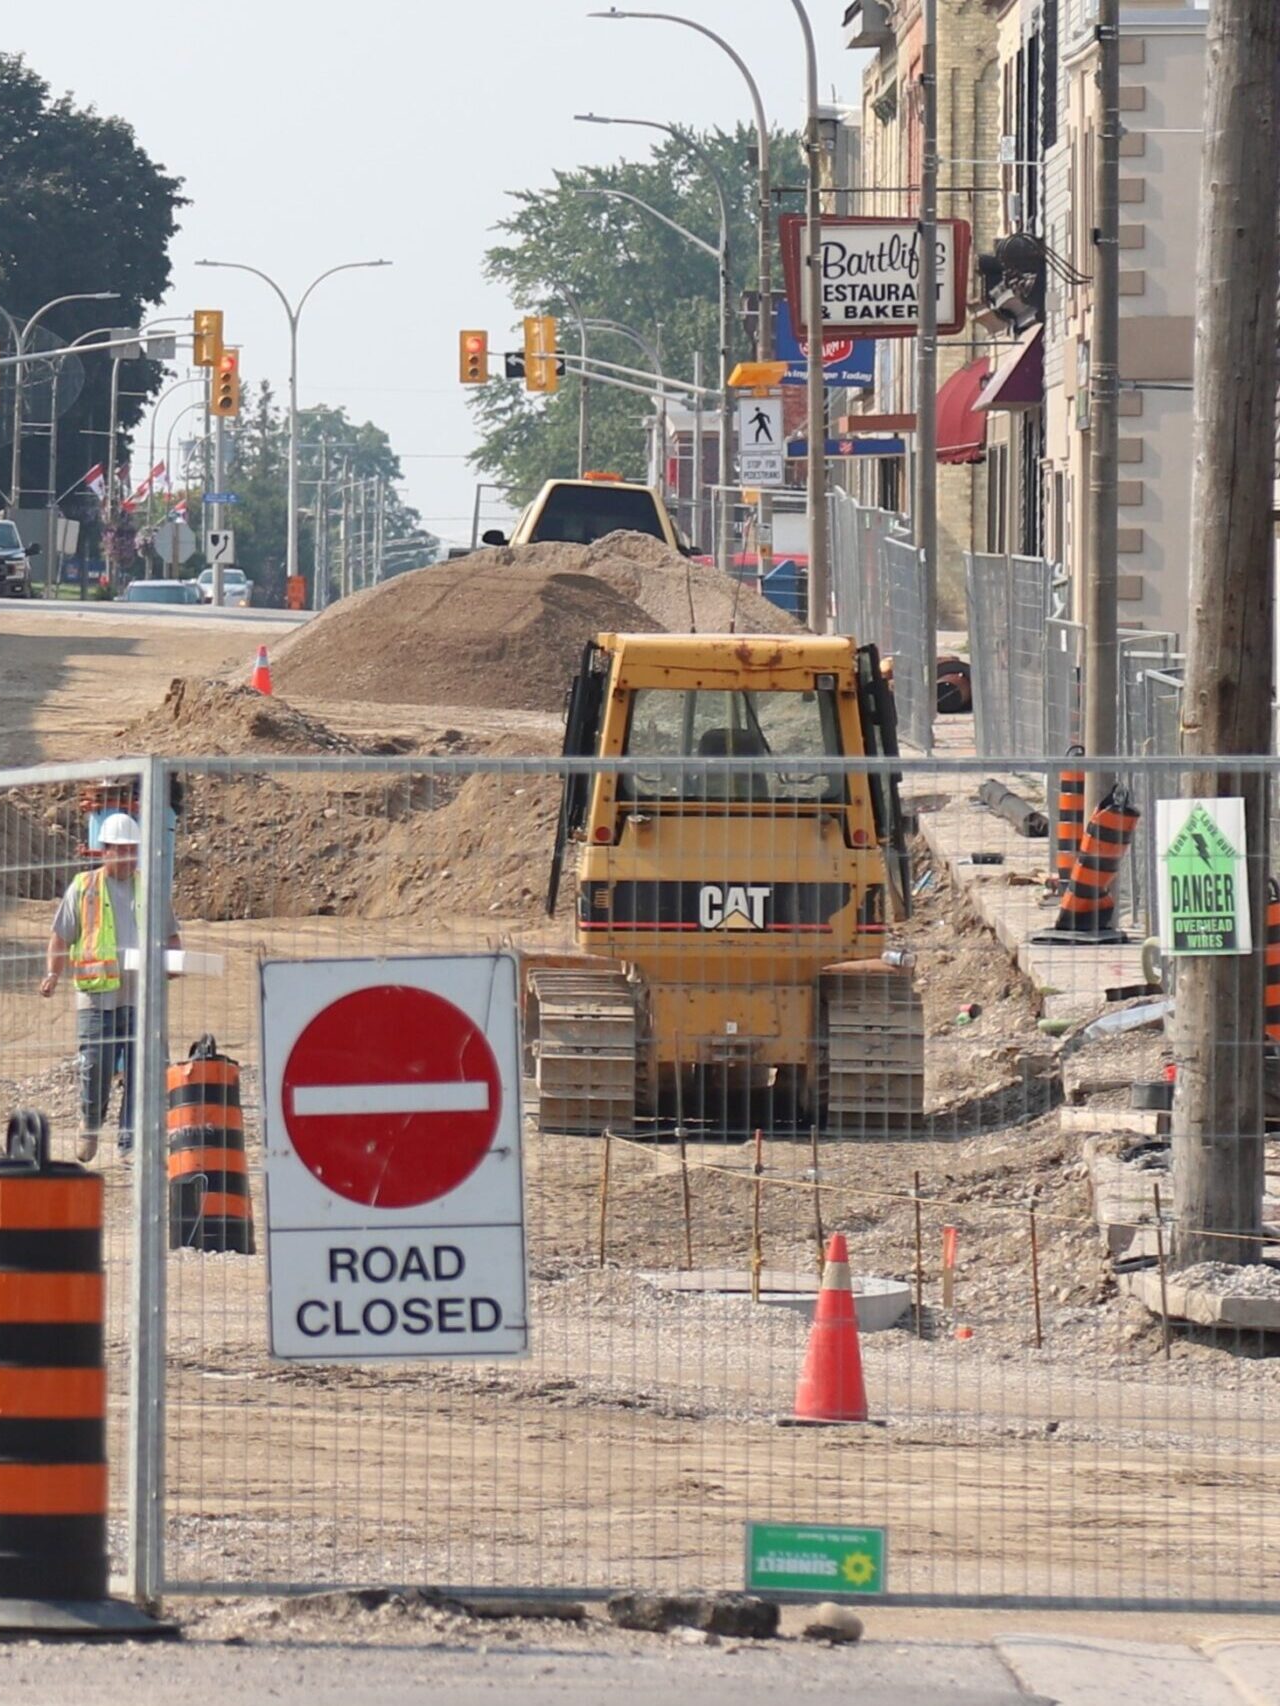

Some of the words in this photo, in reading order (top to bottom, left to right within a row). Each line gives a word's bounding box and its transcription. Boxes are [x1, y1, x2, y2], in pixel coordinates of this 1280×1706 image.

[823, 283, 945, 302] ESTAURAT
[844, 305, 920, 319] BAKER
[699, 885, 770, 929] CAT
[1171, 873, 1235, 913] DANGER
[1175, 918, 1233, 933] OVERHEAD
[1186, 934, 1224, 948] WIRES
[328, 1245, 466, 1283] ROAD
[296, 1297, 503, 1337] CLOSED
